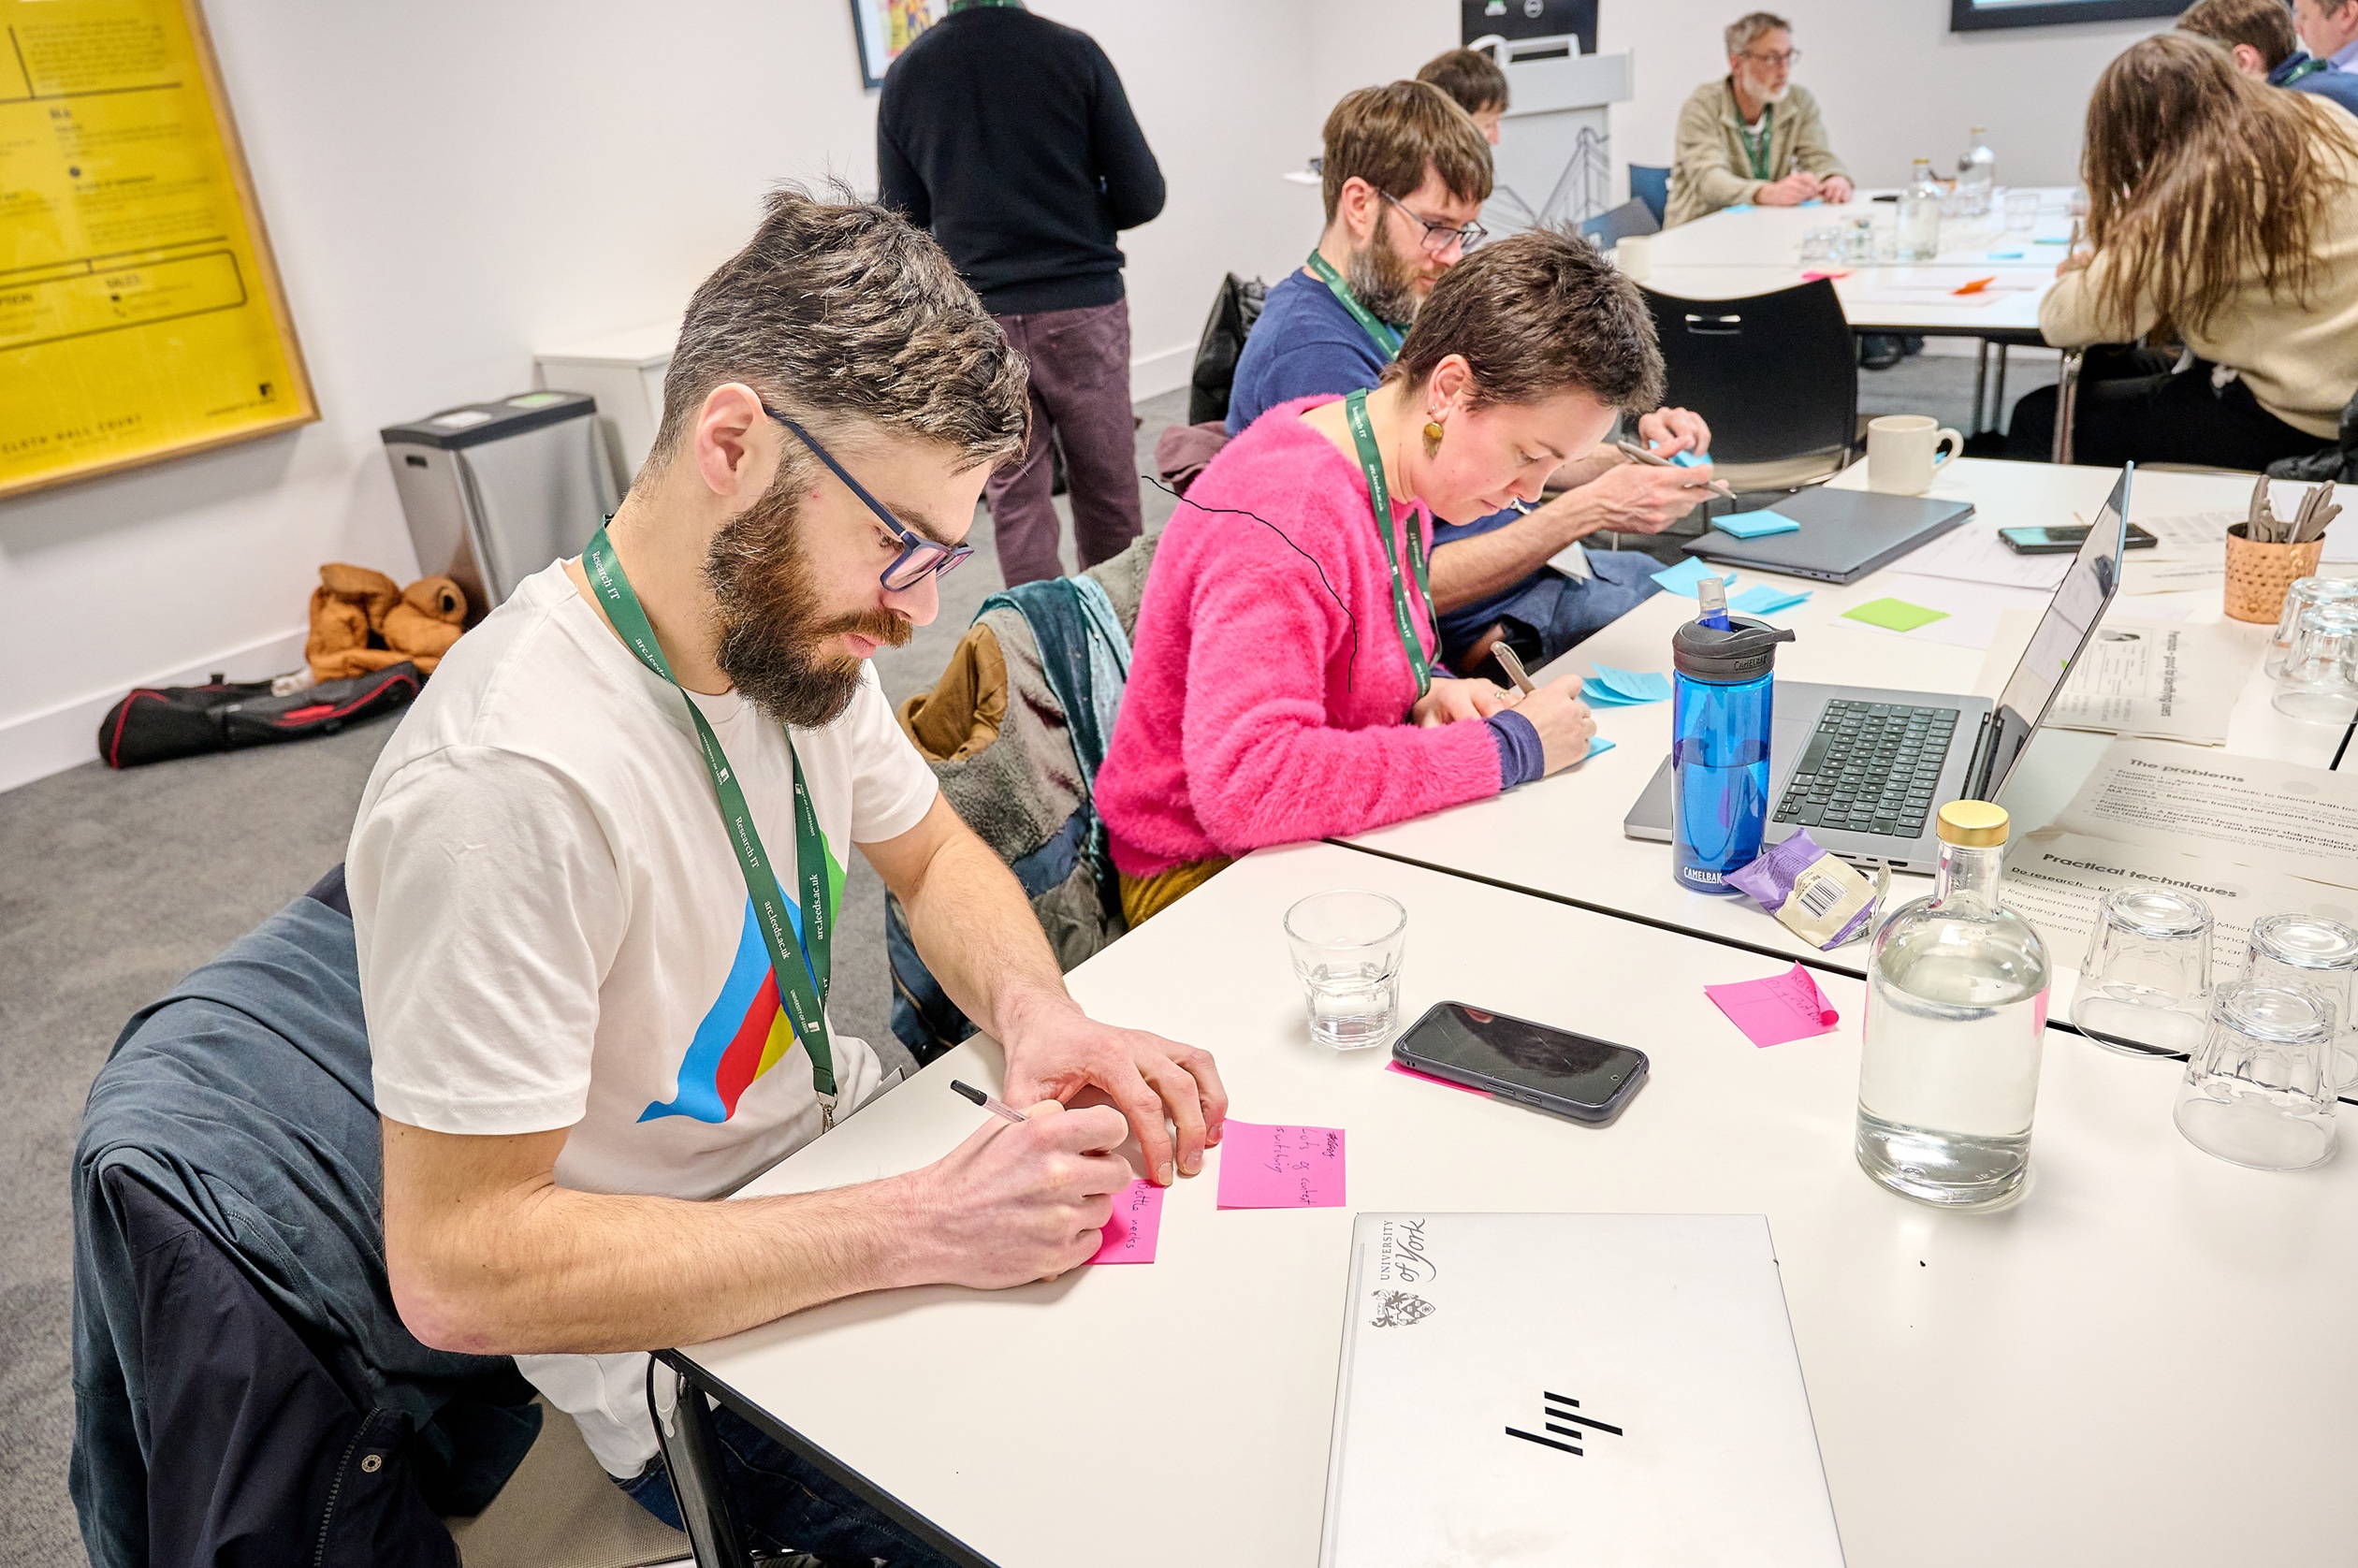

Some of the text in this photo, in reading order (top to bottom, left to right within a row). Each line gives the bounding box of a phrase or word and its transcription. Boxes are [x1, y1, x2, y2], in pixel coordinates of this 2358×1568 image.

[591, 550, 621, 600] Research IT
[1734, 655, 1768, 671] CAMELBAK
[701, 733, 715, 762] UNIVERSITY
[2116, 773, 2154, 782] creative
[2118, 769, 2156, 778] Problem
[2231, 787, 2262, 795] public
[2277, 795, 2316, 804] interact
[2130, 759, 2245, 783] The problems
[2108, 784, 2148, 794] Problem
[2166, 793, 2208, 804] Bespoke
[2211, 801, 2248, 811] training
[2267, 810, 2308, 820] students
[2125, 791, 2158, 800] course
[2097, 804, 2161, 818] collaborators
[2163, 814, 2189, 822] have
[2250, 829, 2274, 837] they
[2277, 834, 2303, 842] want
[2319, 842, 2357, 852] display
[2099, 799, 2139, 809] Problem
[2167, 811, 2214, 822] Research
[2282, 831, 2350, 846] stakeholders
[735, 816, 760, 869] Research IT
[1683, 866, 1723, 884] CAMELBAK
[2011, 866, 2028, 876] Do
[2043, 853, 2237, 897] Practical techniques
[2007, 888, 2089, 912] Requirements
[2014, 878, 2096, 901] Personas and
[808, 873, 823, 940] arc.leeds.ac.uk
[2000, 898, 2096, 925] Mapping perso
[764, 900, 792, 960] arc.leeds.ac.uk
[2028, 917, 2087, 935] Research
[2217, 922, 2251, 933] Mind
[790, 989, 802, 1016] UNIVERSITY
[801, 1020, 809, 1034] LEEDS
[1264, 1125, 1290, 1173] switching
[1299, 1127, 1319, 1150] Lots
[1292, 1160, 1310, 1170] of
[1126, 1183, 1153, 1249] Bottle necks
[1380, 1220, 1393, 1281] UNIVERSITY
[1394, 1217, 1437, 1284] of York
